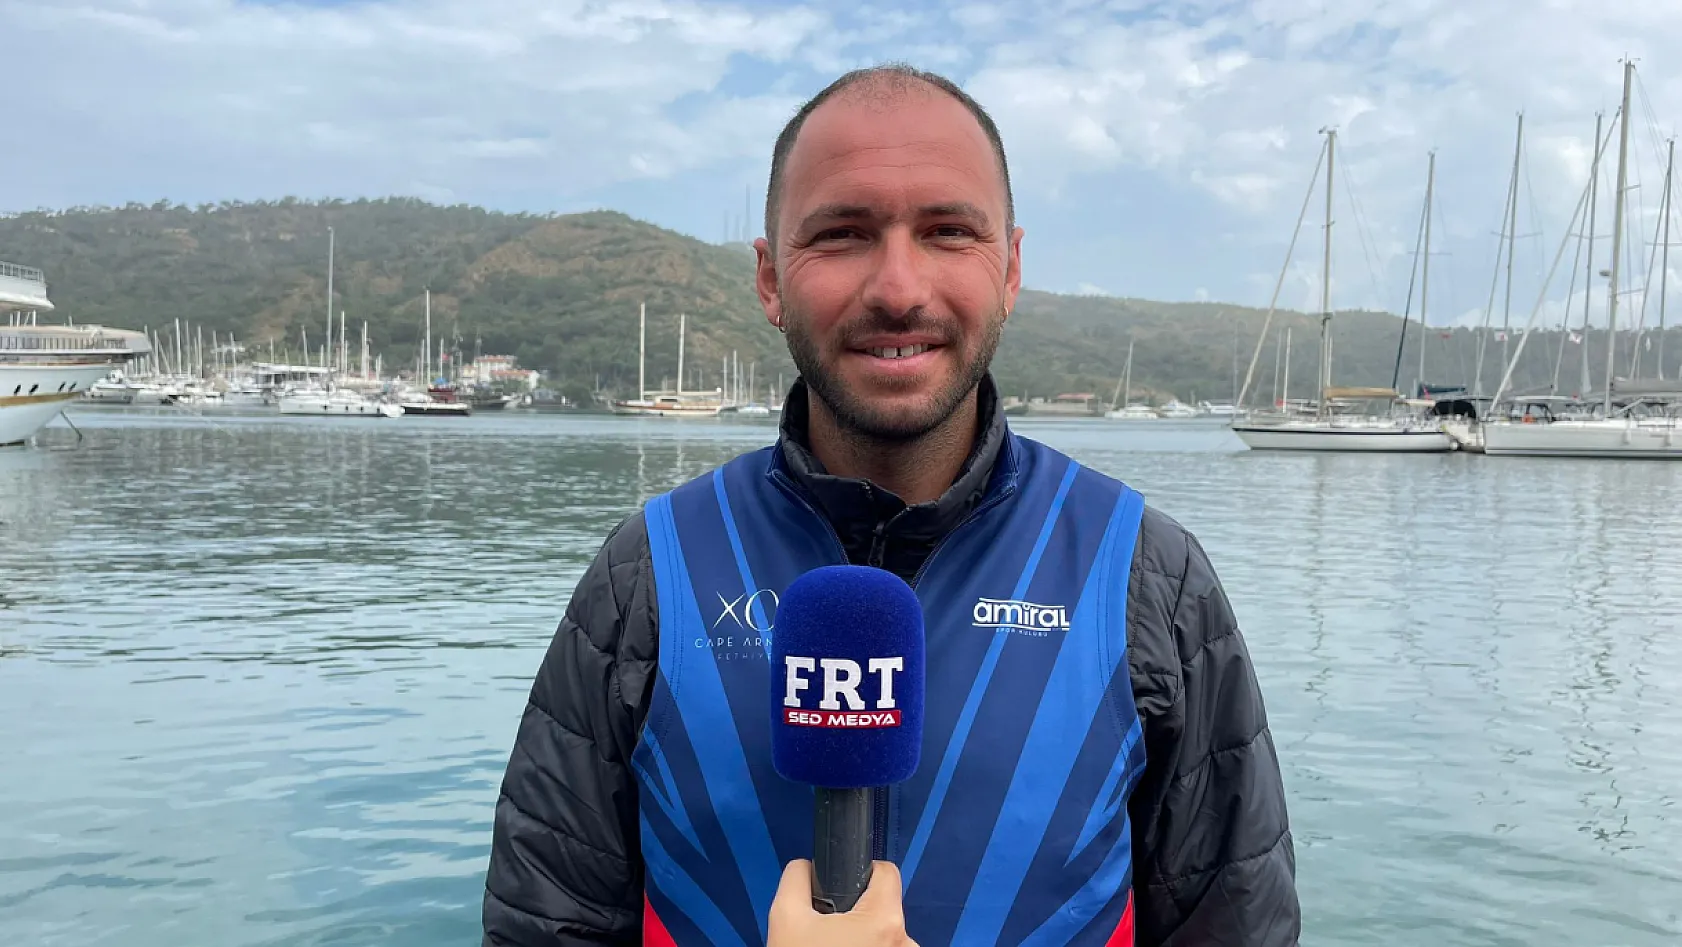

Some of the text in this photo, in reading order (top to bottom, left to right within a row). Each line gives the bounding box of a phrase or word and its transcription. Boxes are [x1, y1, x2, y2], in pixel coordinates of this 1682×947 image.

[712, 588, 779, 631] XO
[694, 637, 773, 648] CAPE ARN
[784, 655, 903, 710] FRT
[788, 711, 896, 726] SED MEDYA
